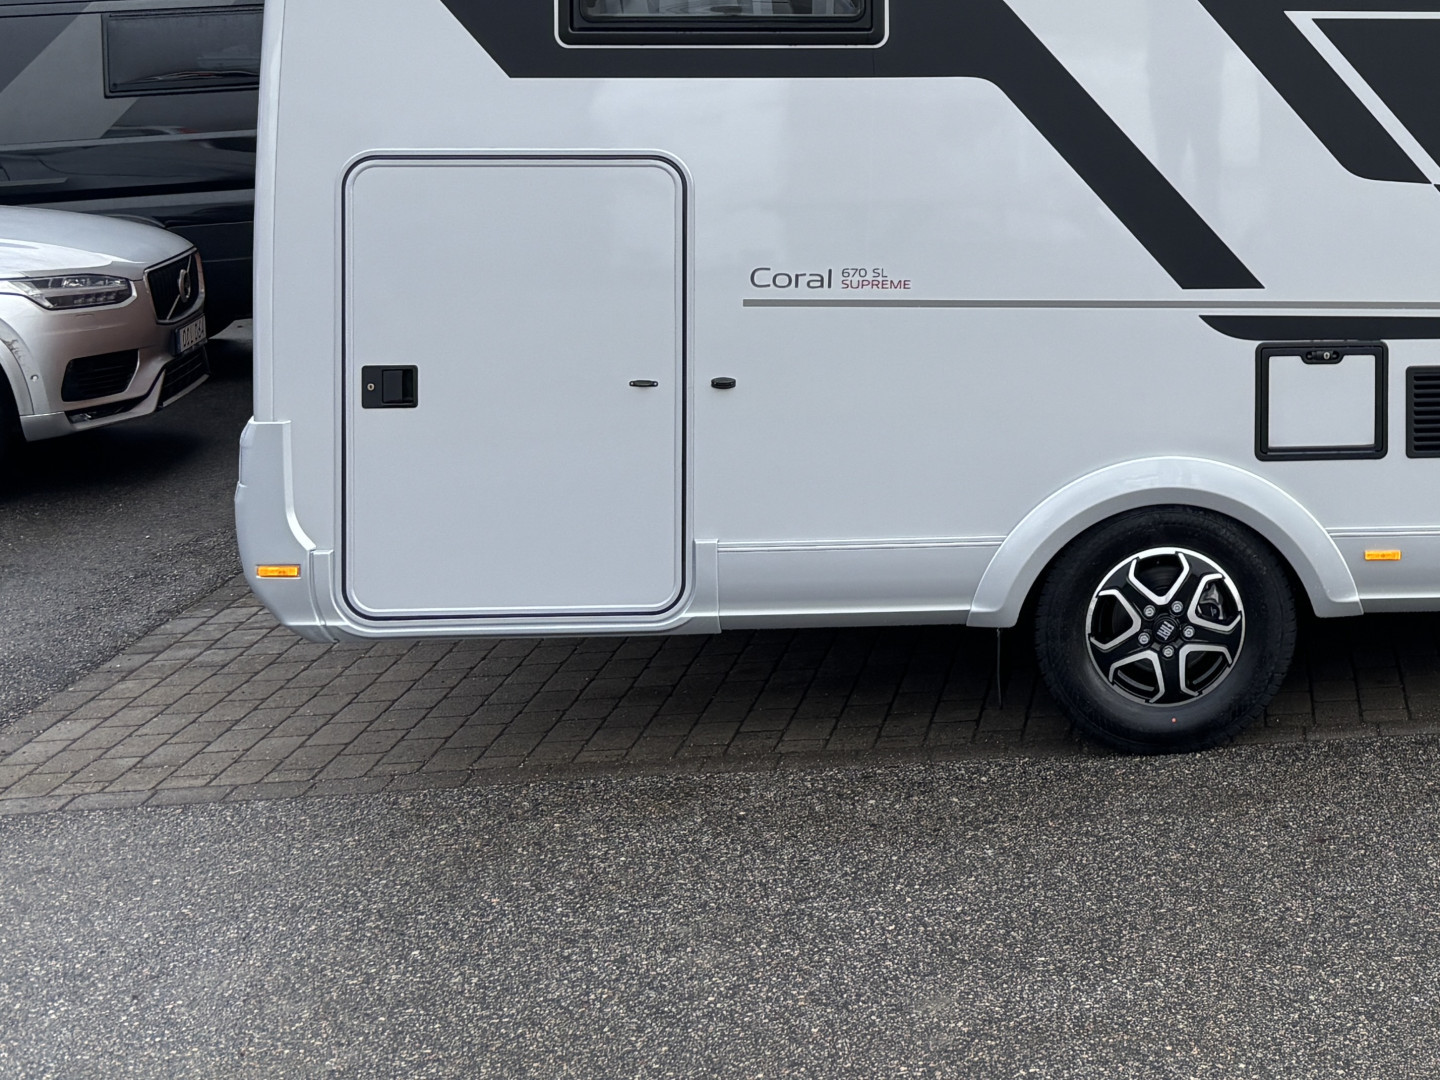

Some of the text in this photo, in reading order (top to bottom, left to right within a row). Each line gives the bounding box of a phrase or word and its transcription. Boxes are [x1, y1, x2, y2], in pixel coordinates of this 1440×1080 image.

[750, 267, 888, 289] Coral 670 SL
[841, 279, 912, 290] SUPREME
[1156, 620, 1175, 641] FIAT
